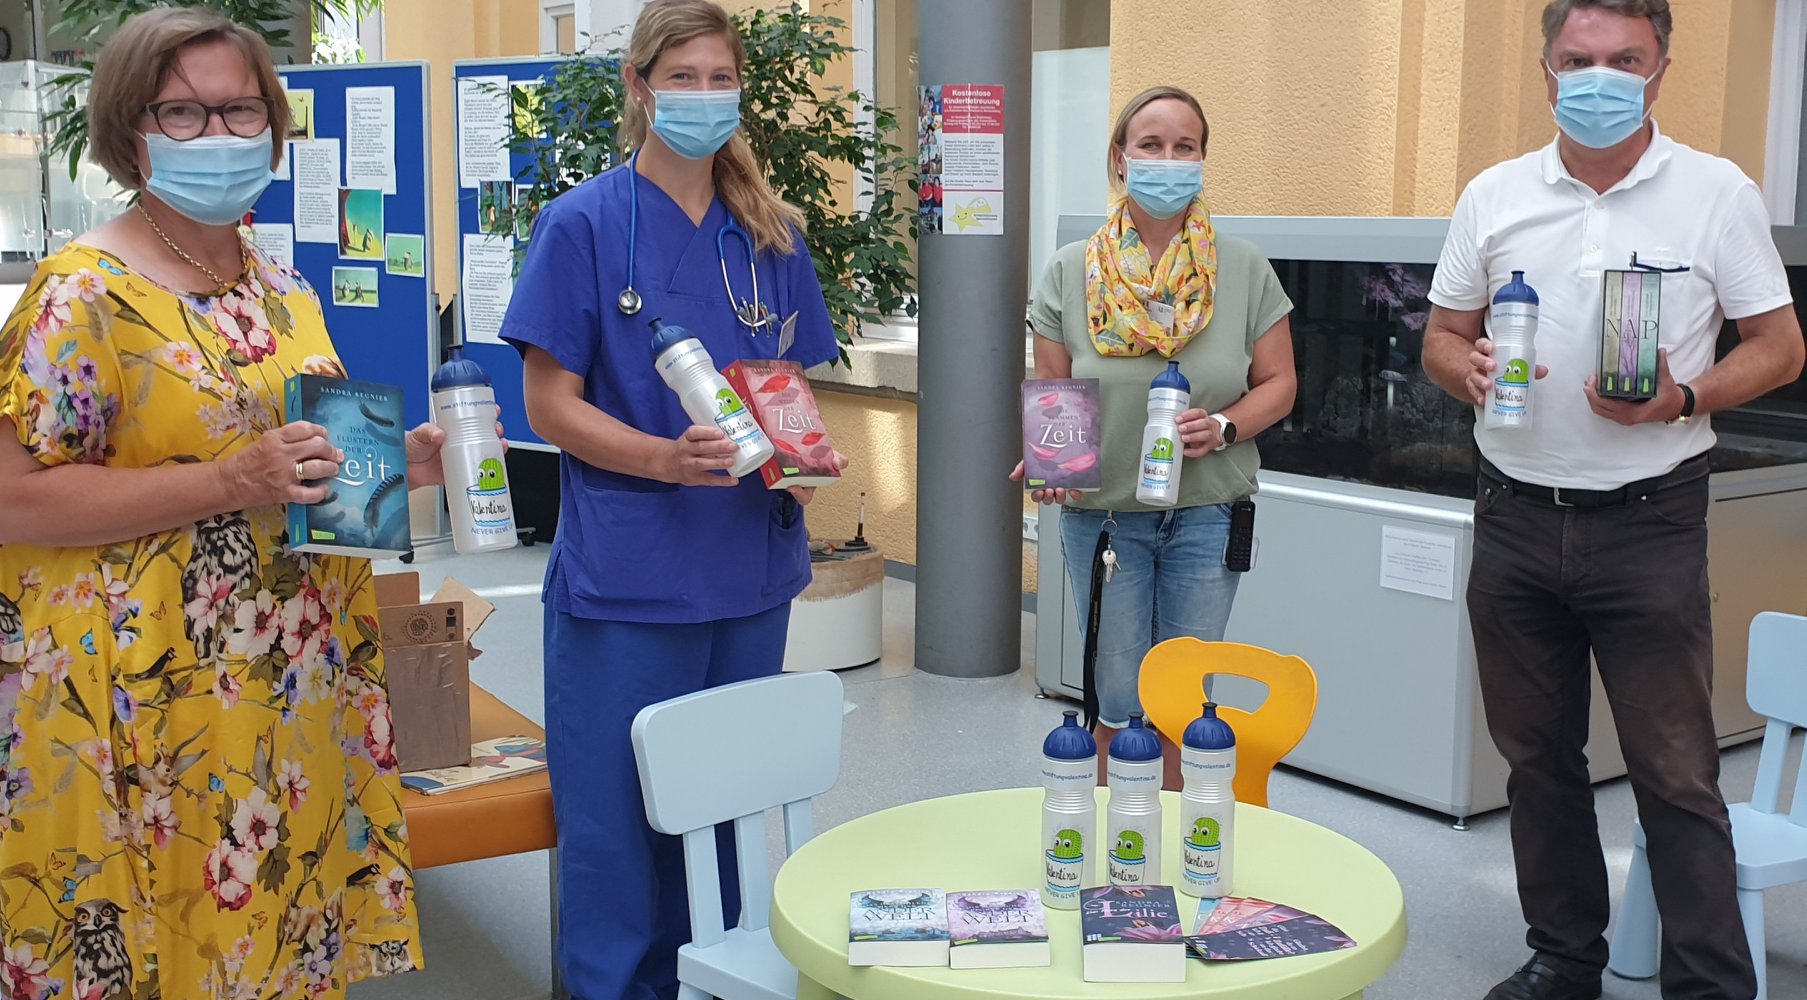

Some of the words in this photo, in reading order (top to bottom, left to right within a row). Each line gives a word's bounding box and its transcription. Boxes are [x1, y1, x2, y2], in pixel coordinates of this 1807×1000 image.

[952, 89, 991, 97] Kostenlose
[943, 97, 1000, 106] Kinderbetreuung
[320, 386, 352, 397] SANDRA
[354, 391, 388, 401] REGNIER
[772, 407, 817, 434] Zeit
[350, 426, 366, 435] DAS
[1040, 424, 1087, 448] Zeit
[470, 499, 507, 515] Valentina
[471, 526, 494, 535] NEVER
[1184, 849, 1215, 868] Valentina
[1046, 861, 1078, 881] Valentina
[1109, 862, 1139, 882] Valentina
[1198, 878, 1213, 887] GIVE
[1060, 891, 1075, 899] GIVE
